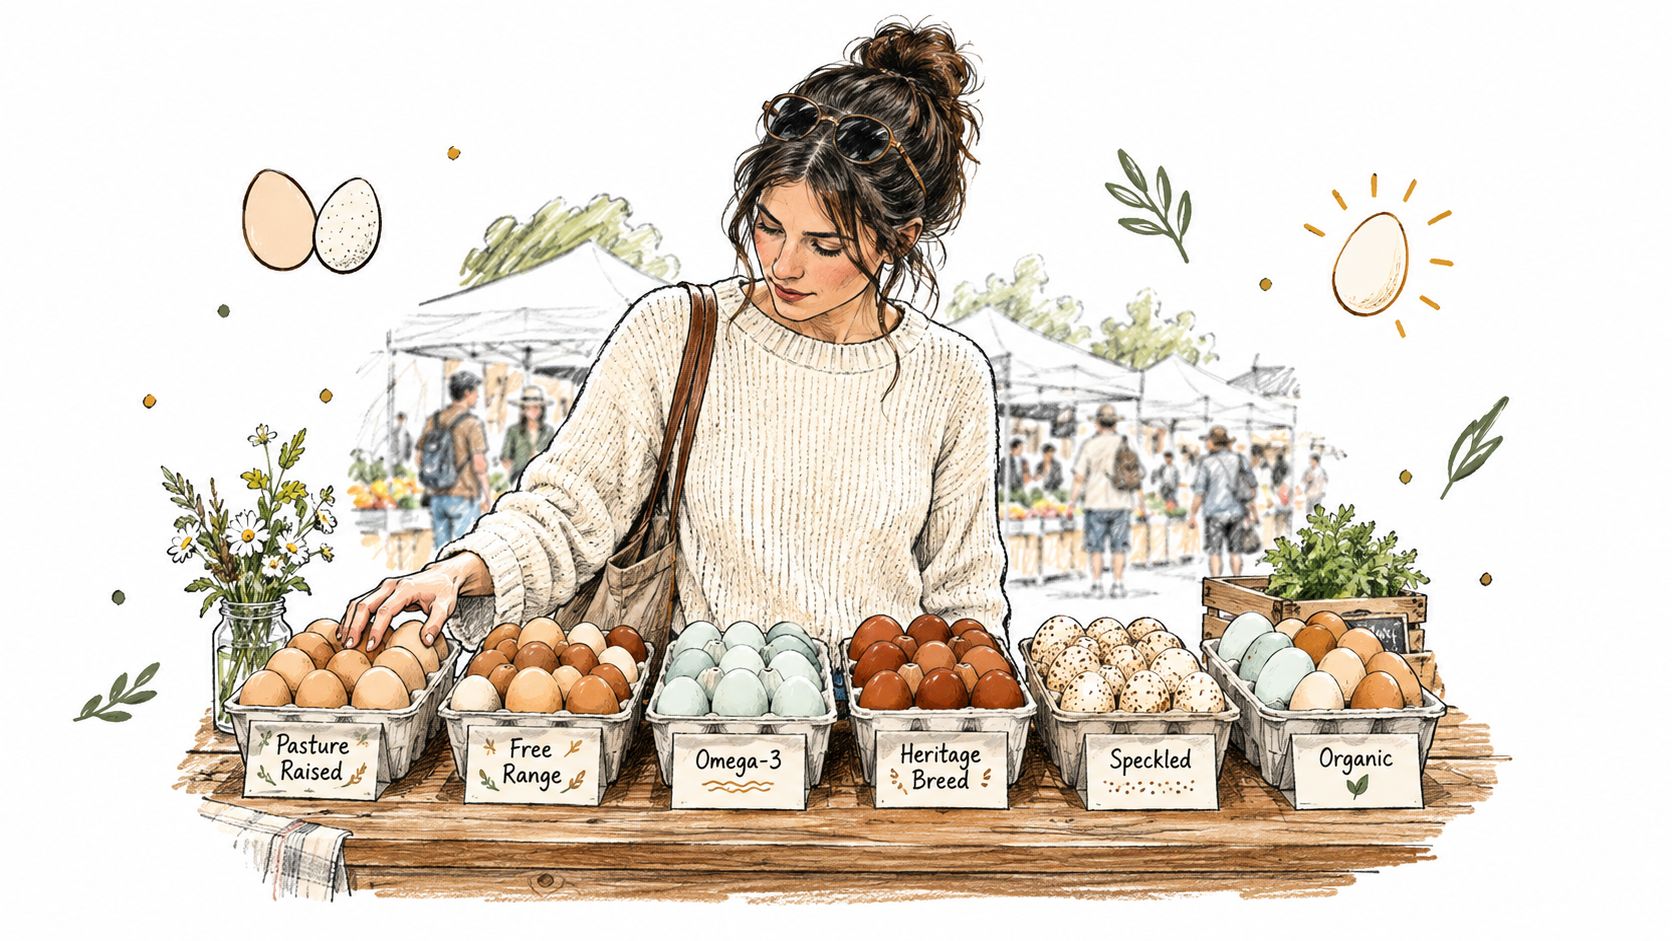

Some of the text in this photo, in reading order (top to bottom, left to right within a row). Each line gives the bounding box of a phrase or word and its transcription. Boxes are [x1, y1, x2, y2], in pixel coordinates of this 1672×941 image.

[276, 733, 350, 755] Pasture
[510, 737, 552, 759] Free
[900, 742, 981, 771] Heritage
[281, 759, 343, 781] Raised
[695, 748, 782, 776] Omega-3
[1110, 747, 1192, 777] Speckled
[1319, 746, 1393, 776] Organic
[503, 762, 562, 791] Range
[912, 765, 969, 790] Breed
